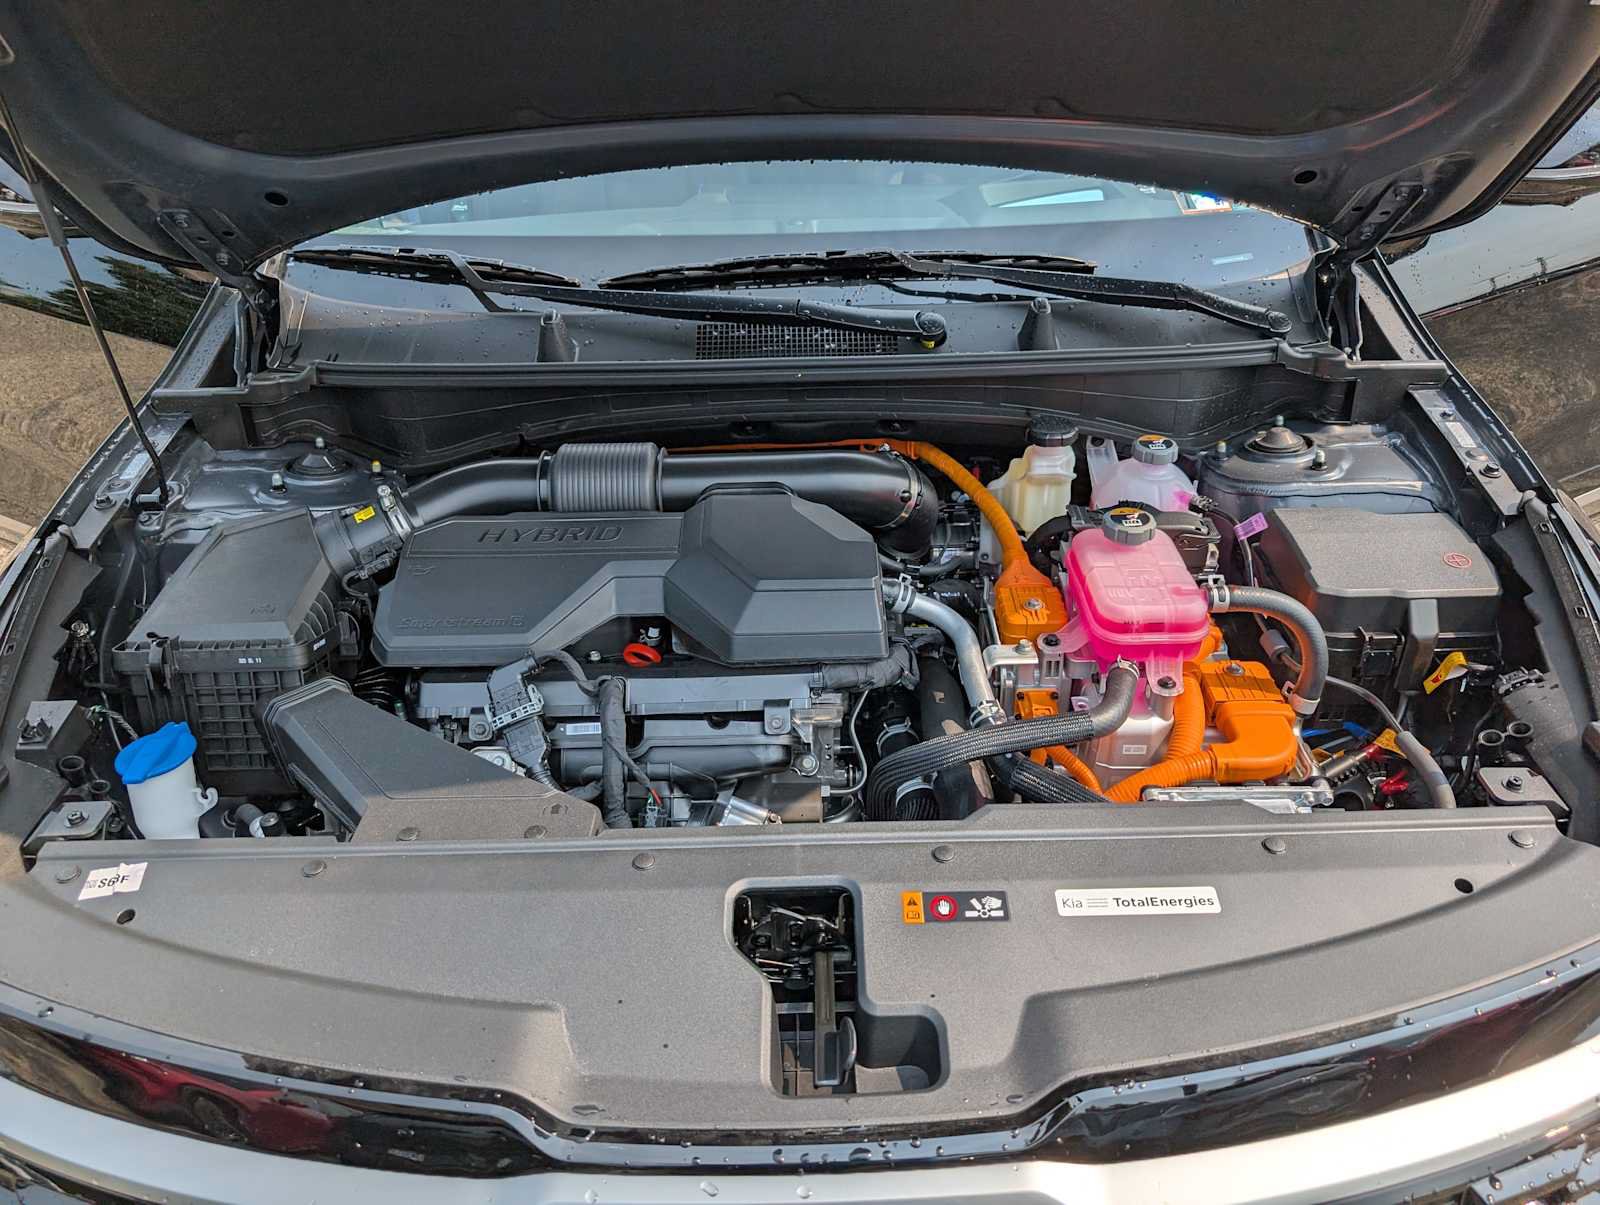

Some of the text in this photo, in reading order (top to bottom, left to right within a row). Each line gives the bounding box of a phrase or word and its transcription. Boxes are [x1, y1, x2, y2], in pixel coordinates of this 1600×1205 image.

[477, 526, 624, 543] HYBRID
[1061, 895, 1215, 909] Kia TotalEnergies
